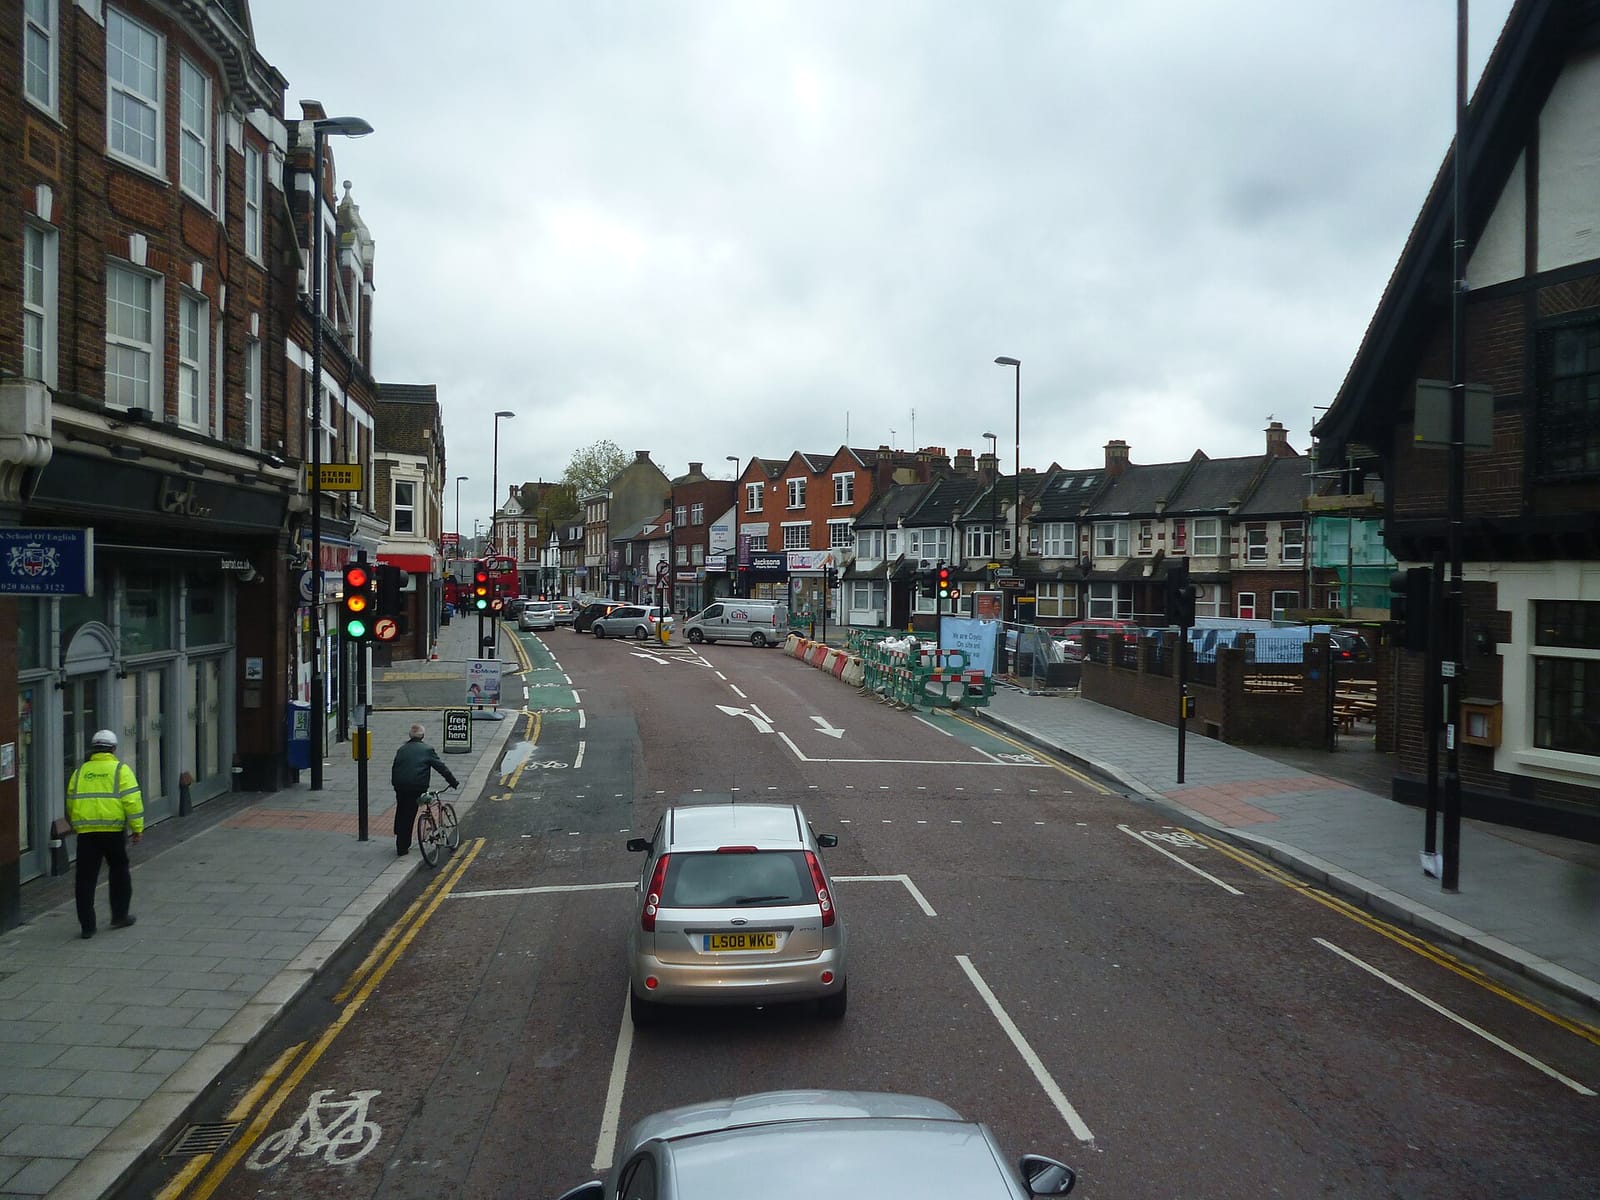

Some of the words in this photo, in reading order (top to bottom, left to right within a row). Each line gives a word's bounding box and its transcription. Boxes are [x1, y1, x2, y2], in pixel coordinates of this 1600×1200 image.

[6, 532, 33, 540] School
[47, 533, 77, 542] English
[753, 558, 781, 566] Jacksons
[449, 715, 466, 724] free
[447, 723, 467, 731] cash
[448, 731, 466, 739] here
[711, 935, 745, 948] LS08
[749, 934, 774, 947] WKG
